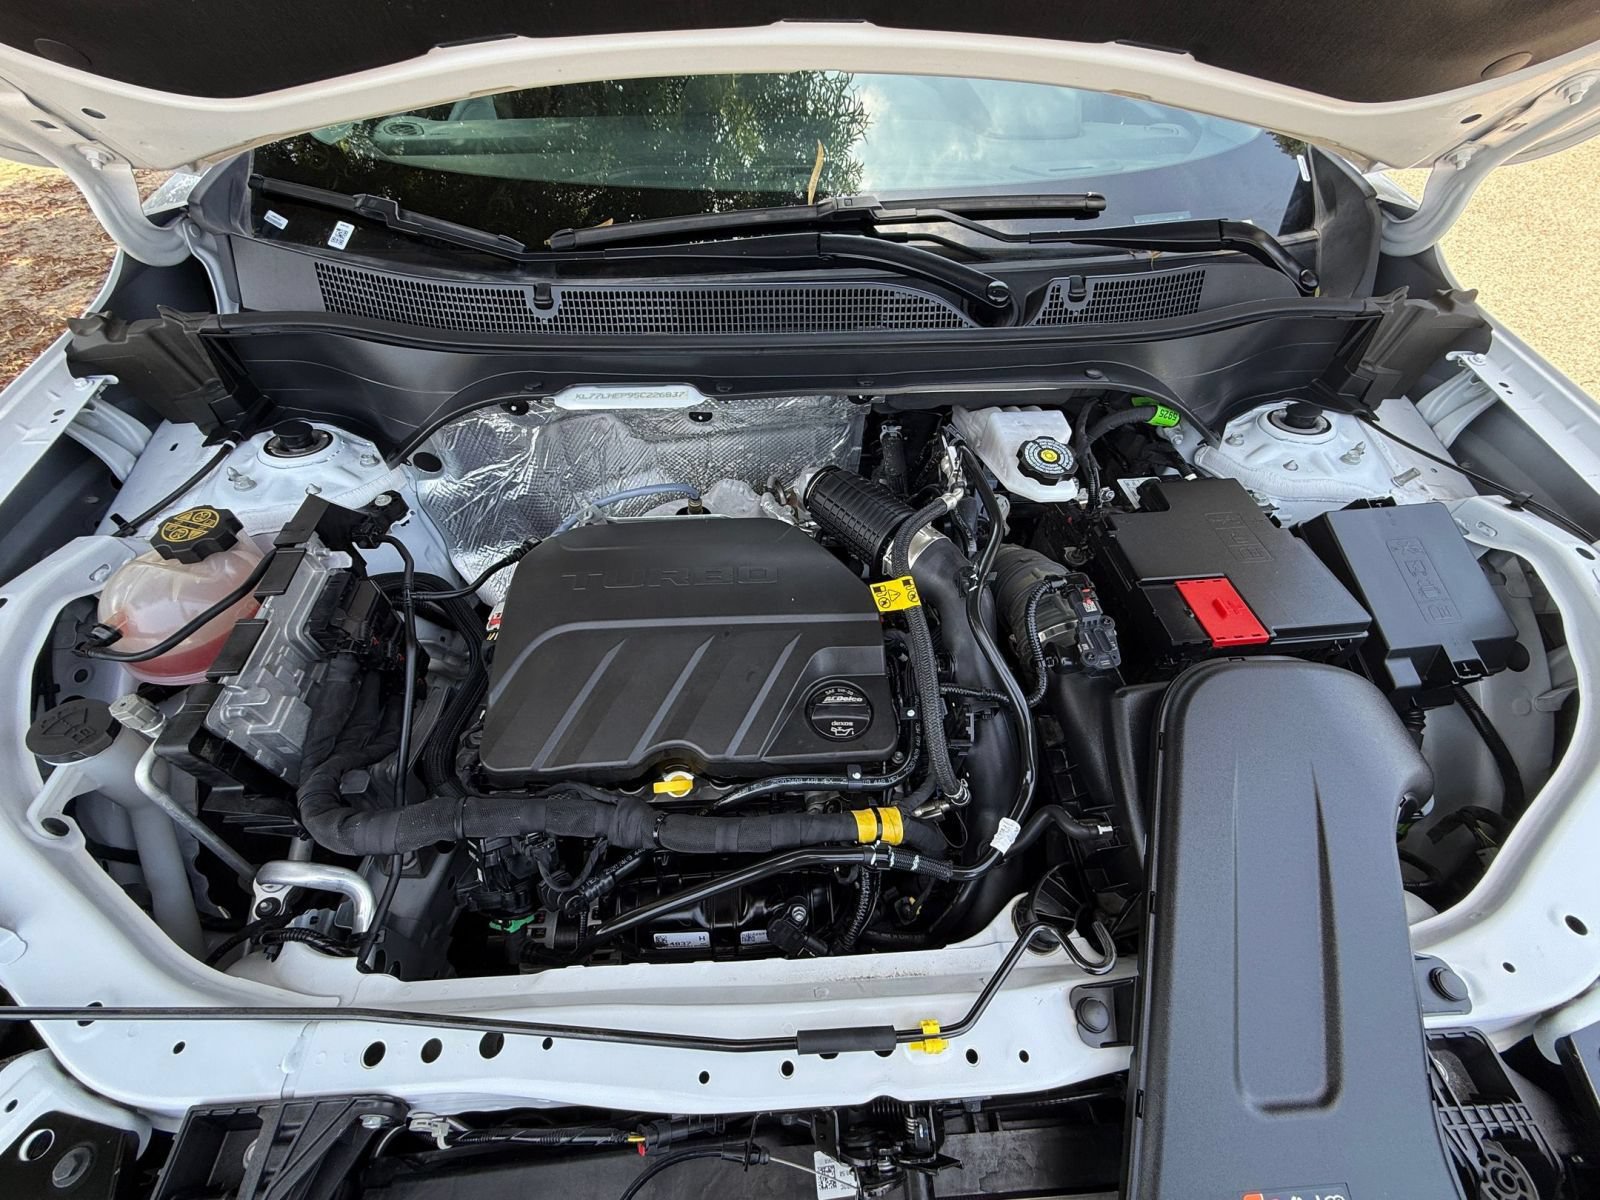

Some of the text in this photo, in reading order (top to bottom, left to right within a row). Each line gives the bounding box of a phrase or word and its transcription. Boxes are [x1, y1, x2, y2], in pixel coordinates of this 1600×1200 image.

[1159, 408, 1178, 421] 5925
[561, 566, 782, 590] TURBO
[821, 695, 863, 704] ACDelco
